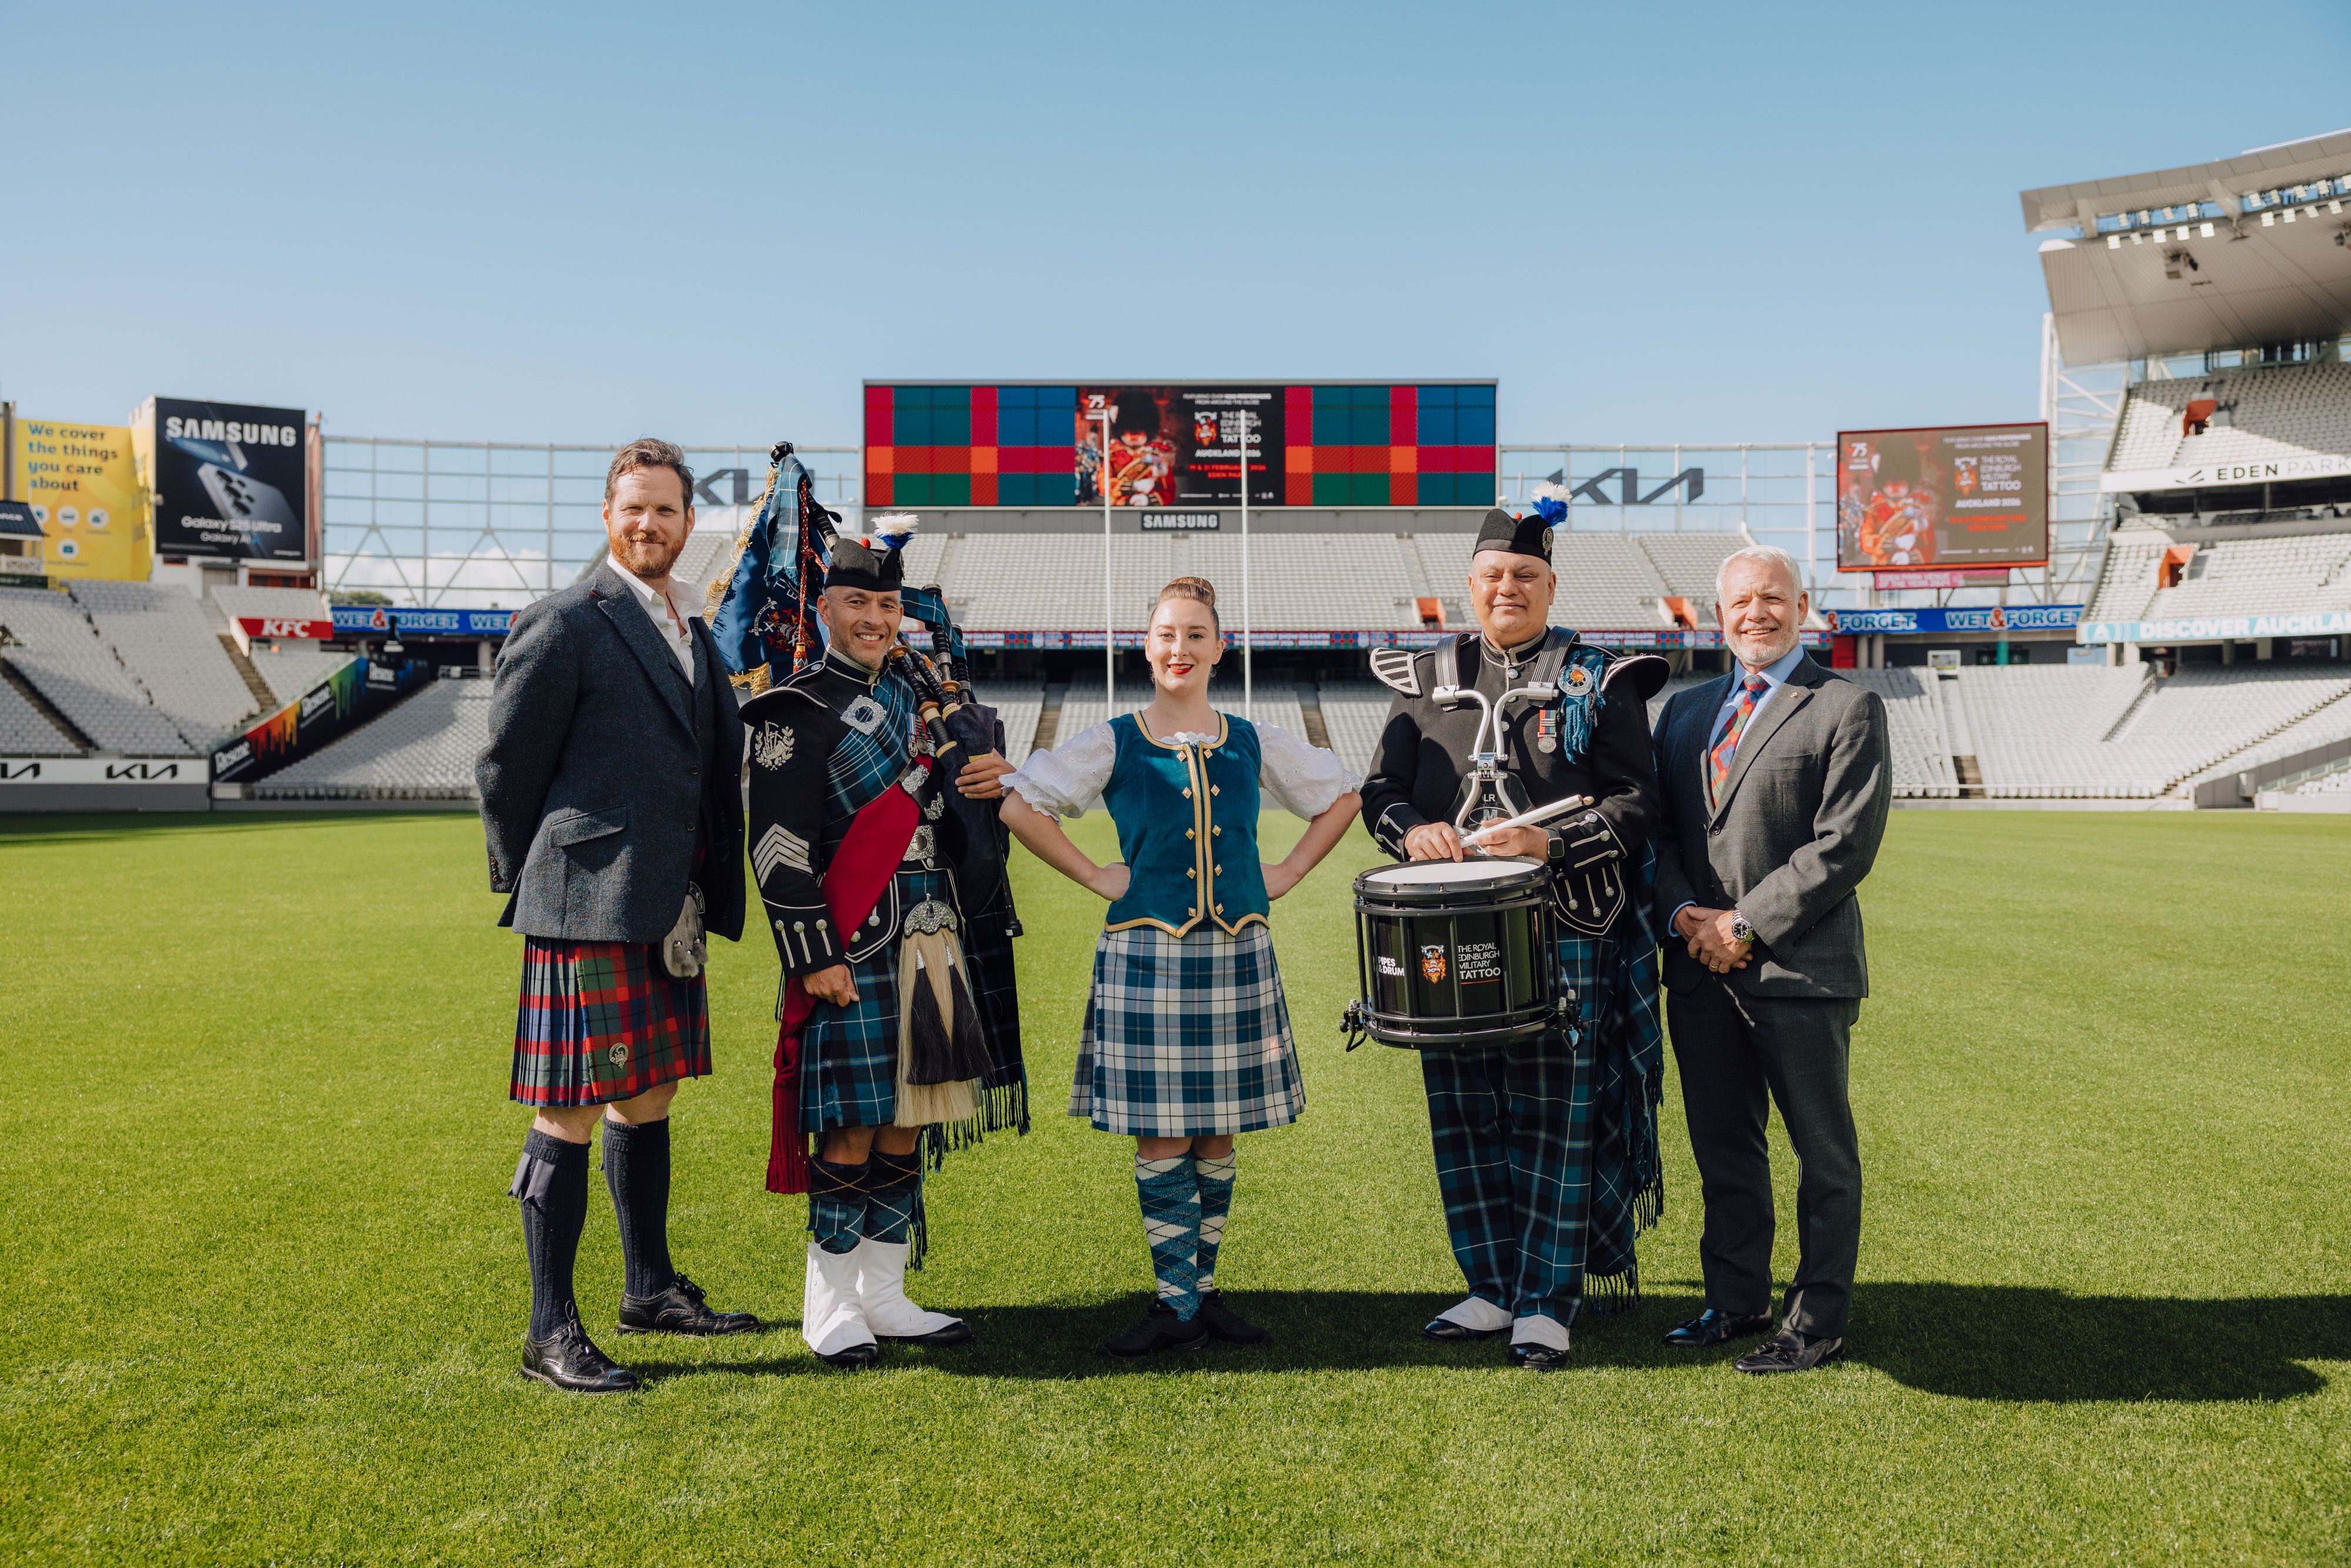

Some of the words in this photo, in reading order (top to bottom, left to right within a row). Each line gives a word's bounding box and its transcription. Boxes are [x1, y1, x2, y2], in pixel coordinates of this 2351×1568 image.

[28, 423, 54, 435] We
[60, 428, 106, 440] cover
[166, 416, 296, 447] SAMSUNG
[1220, 434, 1261, 443] TATOO
[28, 441, 57, 454] the
[63, 445, 118, 461] things
[1980, 455, 1995, 464] THE
[1995, 454, 2018, 463] ROYAL
[28, 462, 60, 474] you
[66, 464, 103, 475] care
[2218, 464, 2278, 480] EDEN
[2288, 455, 2350, 475] PARK
[29, 477, 79, 491] about
[1546, 468, 1703, 504] KIA
[1980, 480, 2022, 491] TATTOO
[1955, 498, 2001, 508] AUCKLAND
[181, 515, 229, 532] Galaxy
[250, 519, 282, 533] Ultra
[1143, 514, 1218, 528] SAMSUNG
[200, 531, 239, 545] Galaxy
[260, 620, 311, 638] KFC
[2139, 618, 2251, 639] DISCOVER
[106, 763, 178, 779] KIA
[1458, 944, 1472, 953] THE
[1473, 942, 1497, 951] ROYAL
[1378, 956, 1396, 967] PIPES
[1458, 950, 1500, 961] EDINBURGH
[1459, 959, 1491, 970] MILITARY
[1460, 967, 1501, 979] TATTOO
